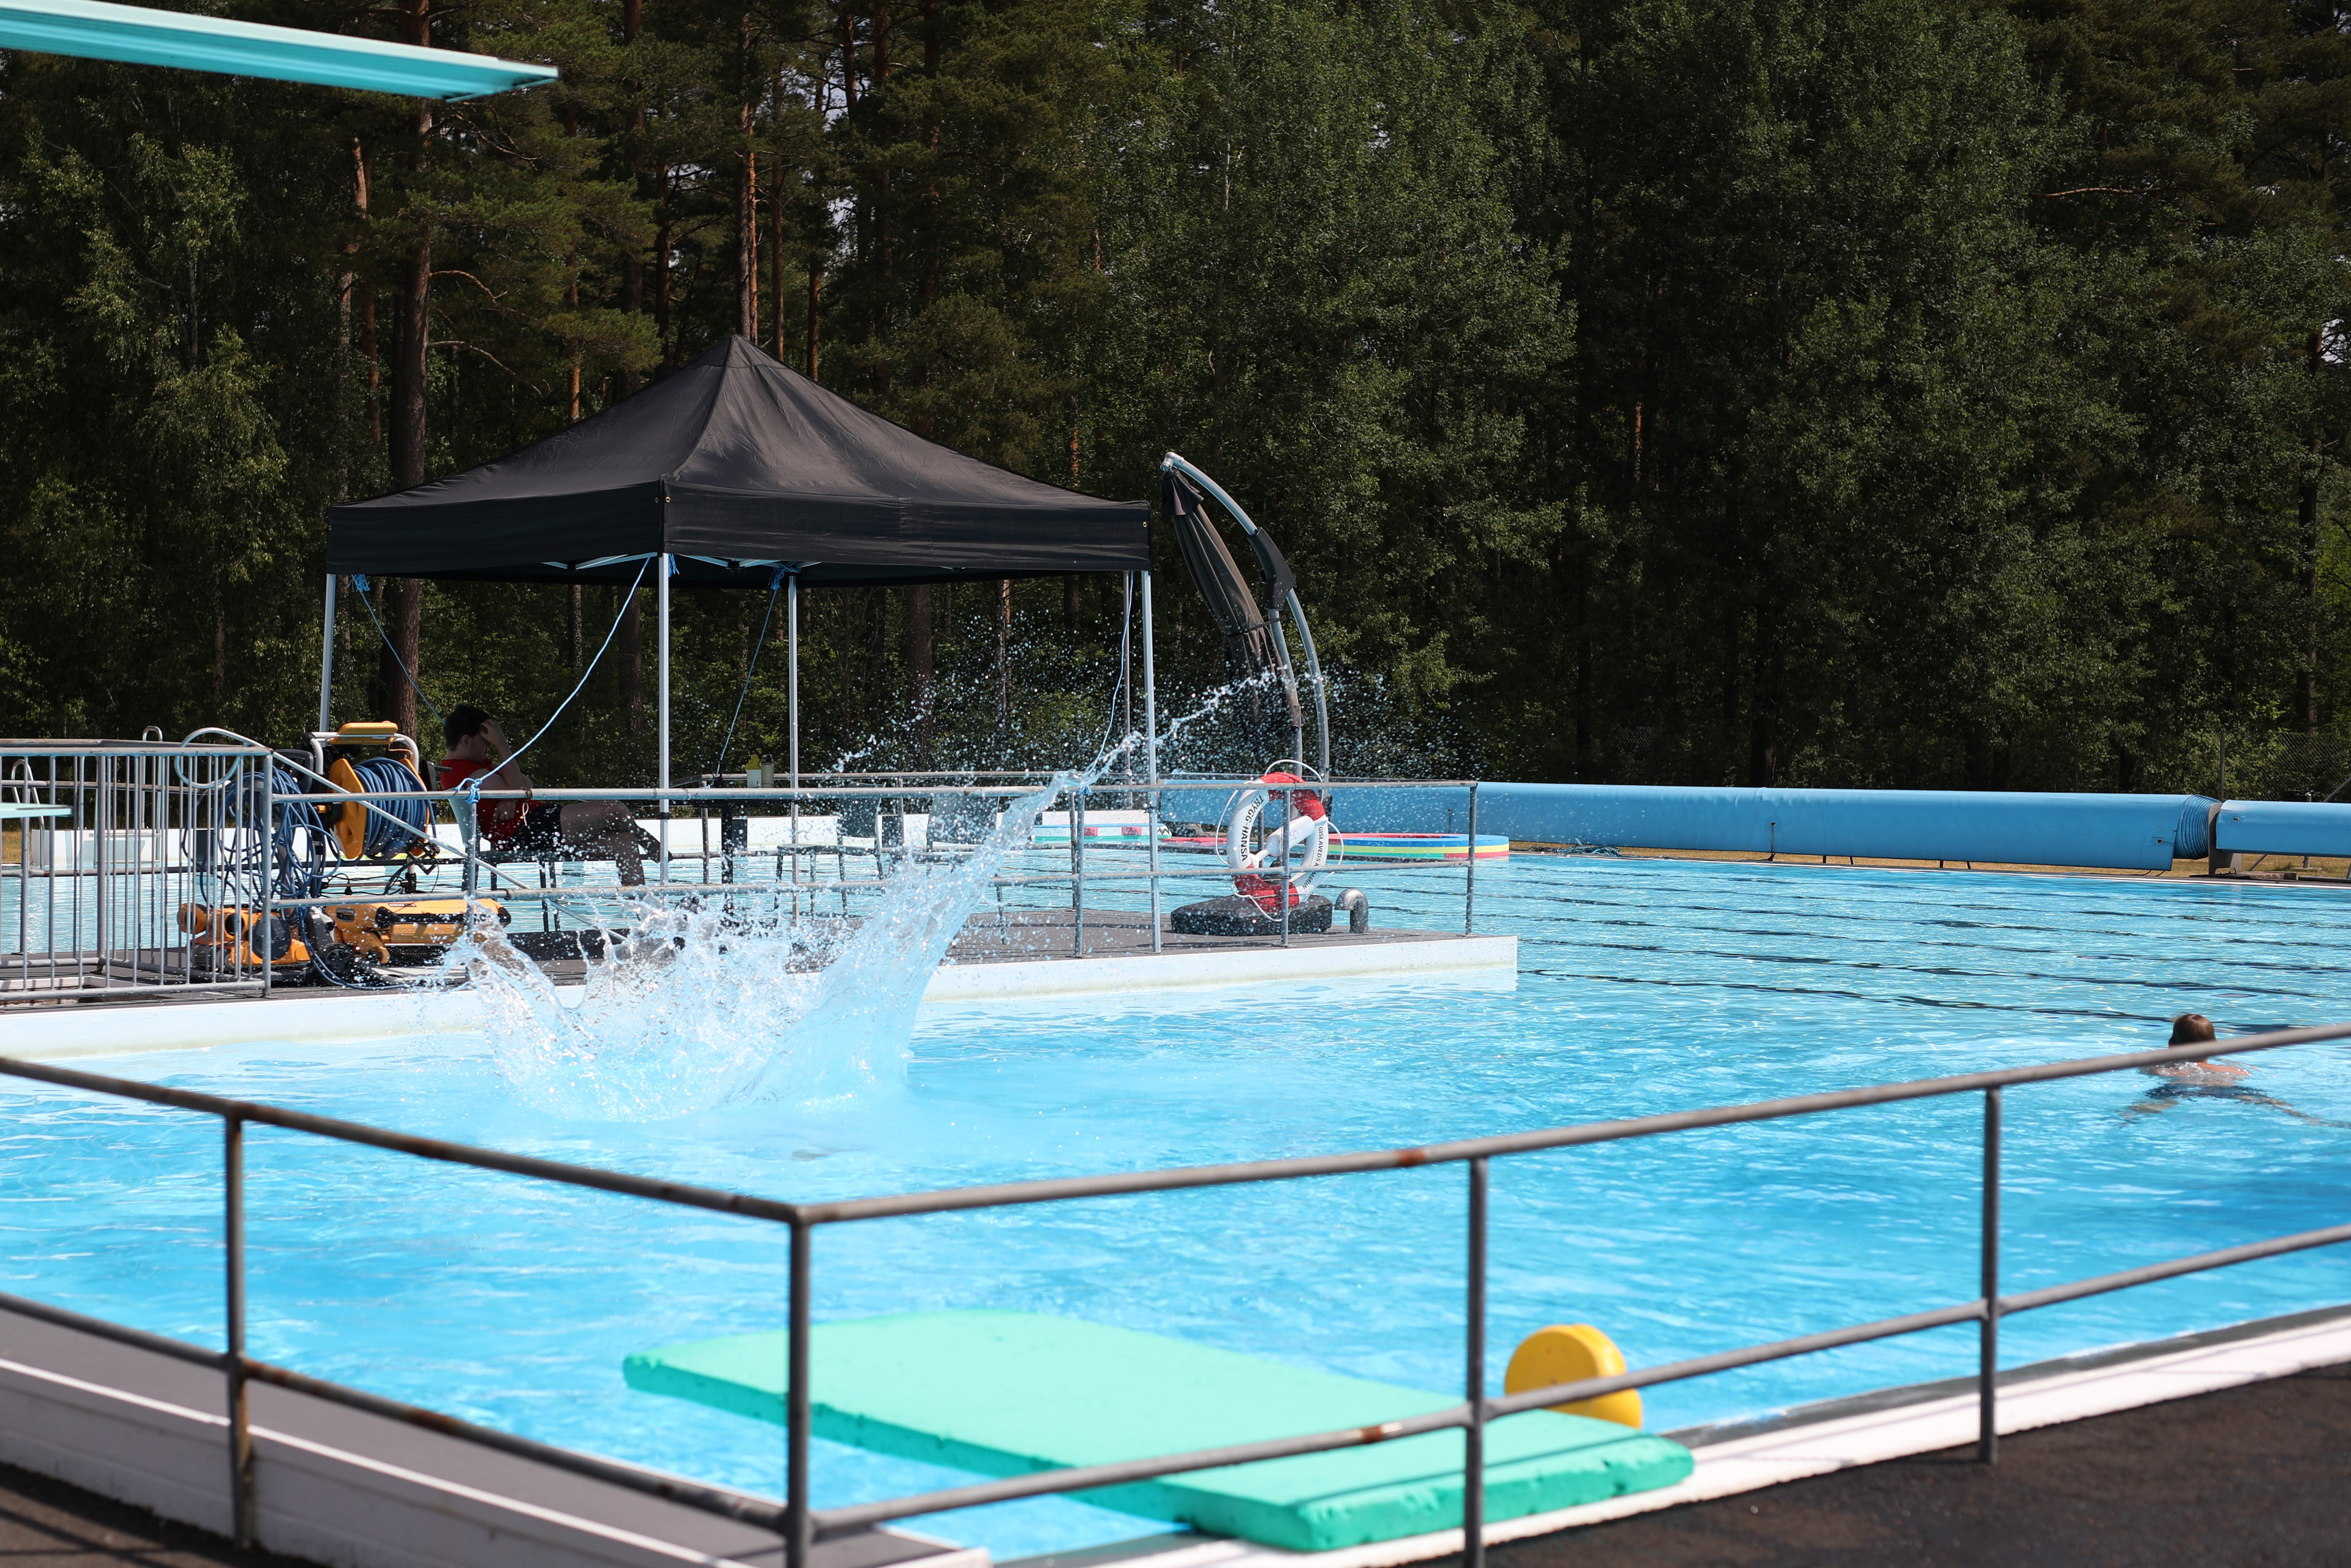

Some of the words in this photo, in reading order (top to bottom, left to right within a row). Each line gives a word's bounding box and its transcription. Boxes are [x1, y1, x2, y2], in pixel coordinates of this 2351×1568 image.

[1240, 794, 1264, 862] TRYGG-HANSA
[1316, 827, 1324, 863] GISLAVEDS
[1302, 862, 1319, 890] KMMUN
